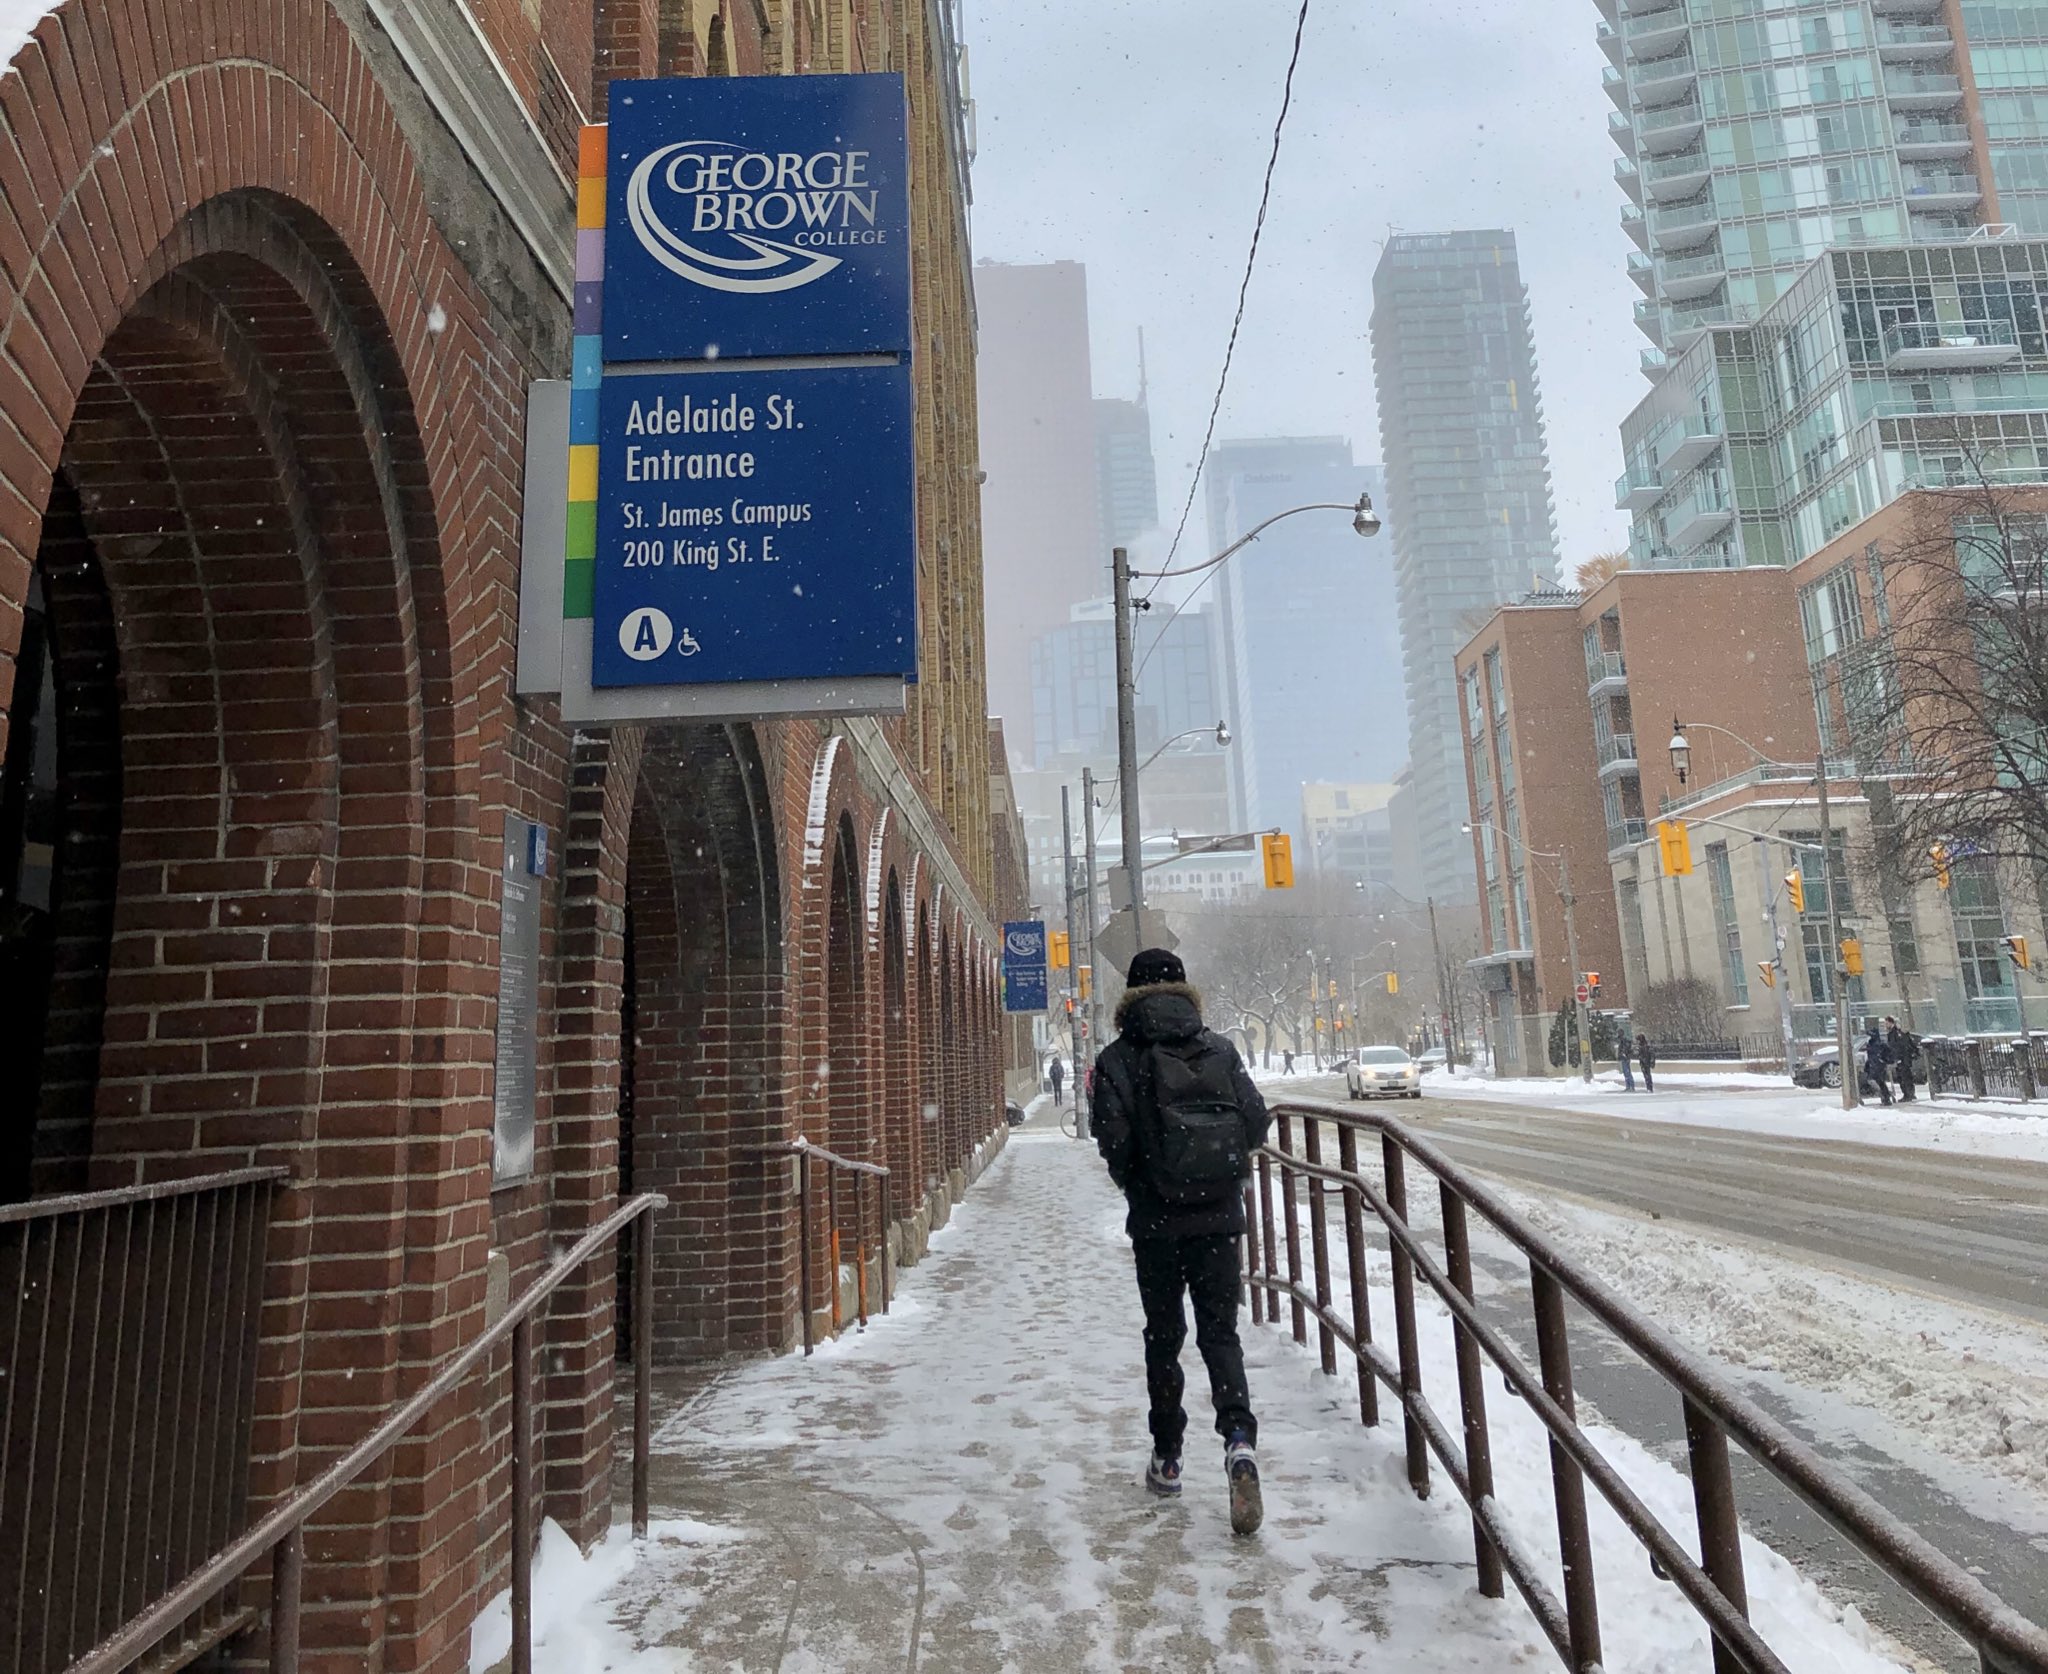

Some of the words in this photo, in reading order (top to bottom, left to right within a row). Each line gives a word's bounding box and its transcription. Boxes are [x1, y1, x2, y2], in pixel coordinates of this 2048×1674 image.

[666, 151, 869, 194] GEORGE
[692, 190, 879, 232] BROWN
[794, 230, 887, 246] COLLEGE
[625, 394, 755, 435] Adelaide
[766, 394, 805, 430] St.
[626, 446, 755, 482] Entrance
[624, 503, 650, 528] St.
[657, 501, 723, 527] James
[731, 498, 812, 529] Campus
[623, 541, 664, 568] 200
[673, 540, 719, 571] King
[727, 537, 753, 564] St.
[763, 535, 780, 562] E.
[633, 615, 659, 652] A
